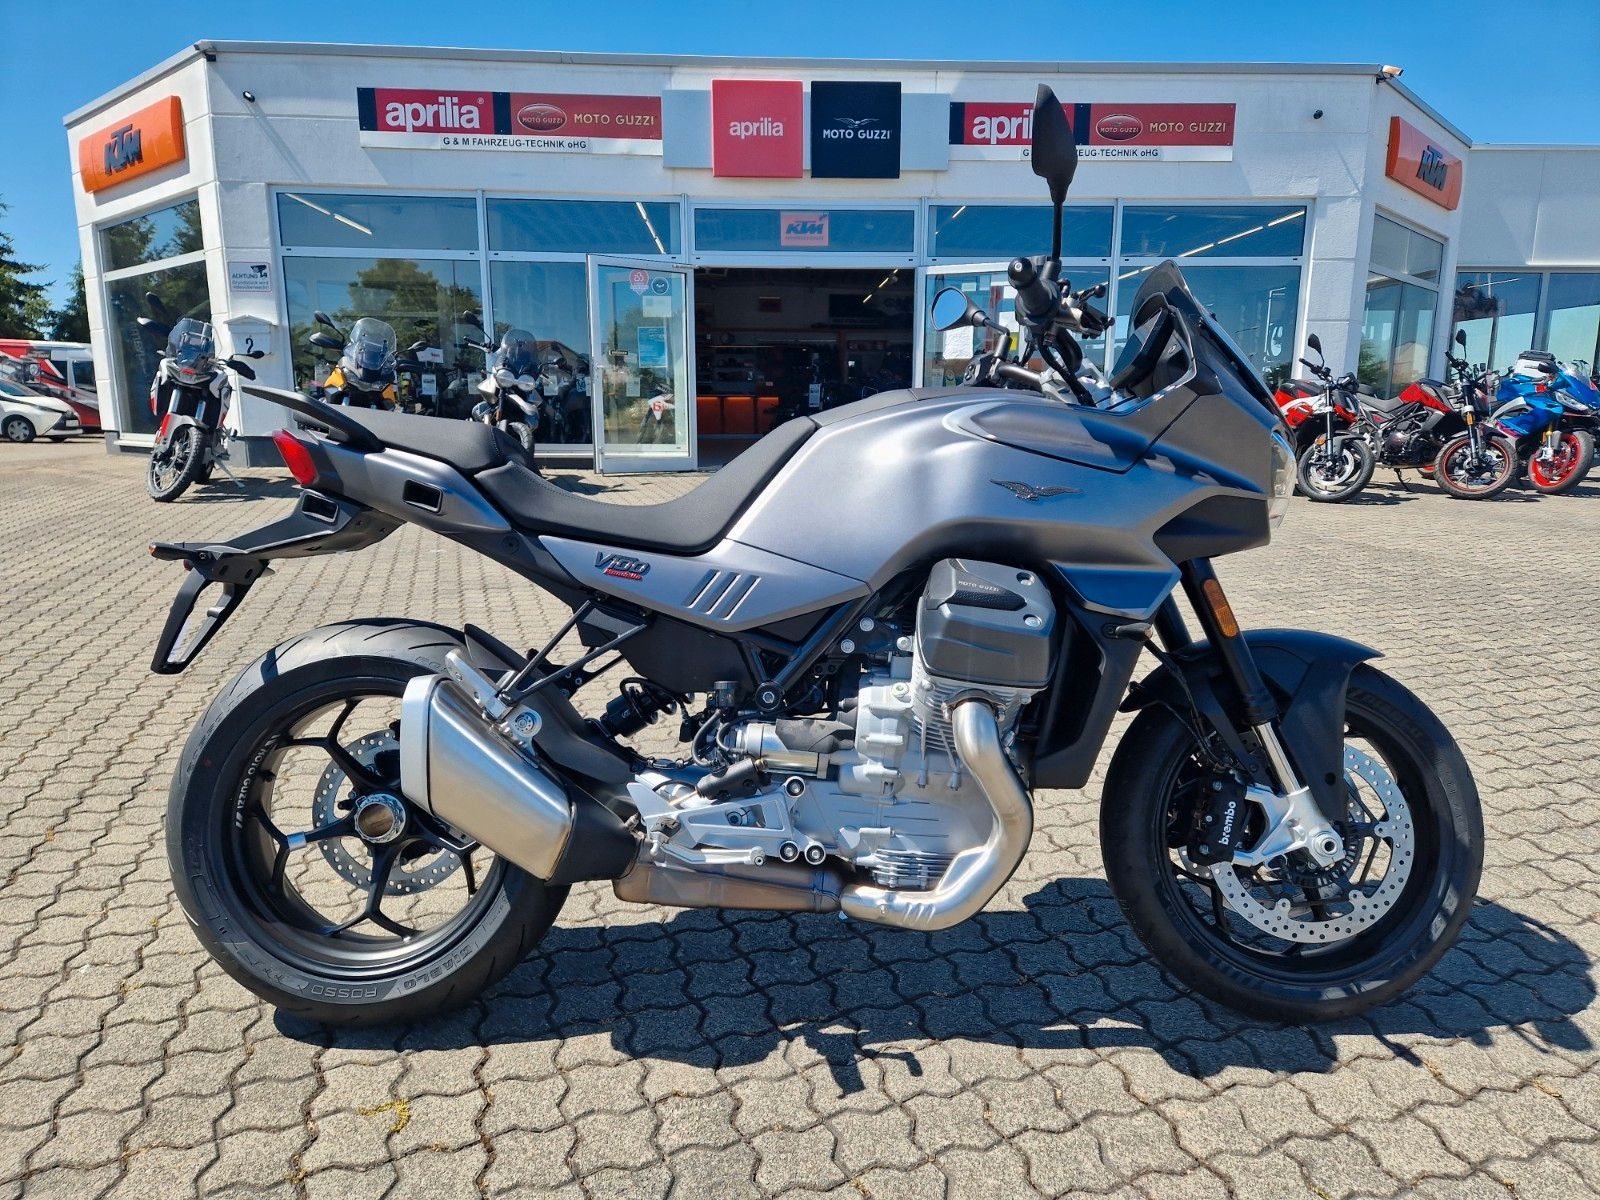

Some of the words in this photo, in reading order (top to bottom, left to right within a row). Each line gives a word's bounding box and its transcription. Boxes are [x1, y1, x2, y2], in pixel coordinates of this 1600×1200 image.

[385, 96, 480, 132] aprilia
[574, 114, 610, 124] MOTO
[615, 115, 654, 126] GUZZI
[729, 117, 784, 139] aprilia
[823, 129, 854, 139] MOTO
[858, 129, 890, 139] GUZZI
[973, 109, 1033, 144] april
[1149, 122, 1184, 132] MOTO
[1189, 122, 1226, 132] GUZZI
[104, 123, 143, 176] KTM
[443, 137, 450, 146] G
[453, 137, 460, 146] &
[462, 137, 470, 146] M
[472, 137, 565, 149] FAHRZEUG-TECHNIK
[567, 140, 587, 149] oHG
[1023, 149, 1030, 157] G
[1140, 149, 1159, 157] oHG
[1416, 145, 1448, 191] KTM
[785, 220, 824, 235] KTM
[245, 337, 254, 354] 2
[594, 551, 651, 576] V100
[958, 580, 977, 588] MOTO
[979, 584, 1000, 592] GUZZI
[247, 748, 268, 775] MOTO
[237, 777, 251, 810] GUZZI
[1218, 801, 1237, 846] brembo
[310, 984, 378, 999] ROSSO
